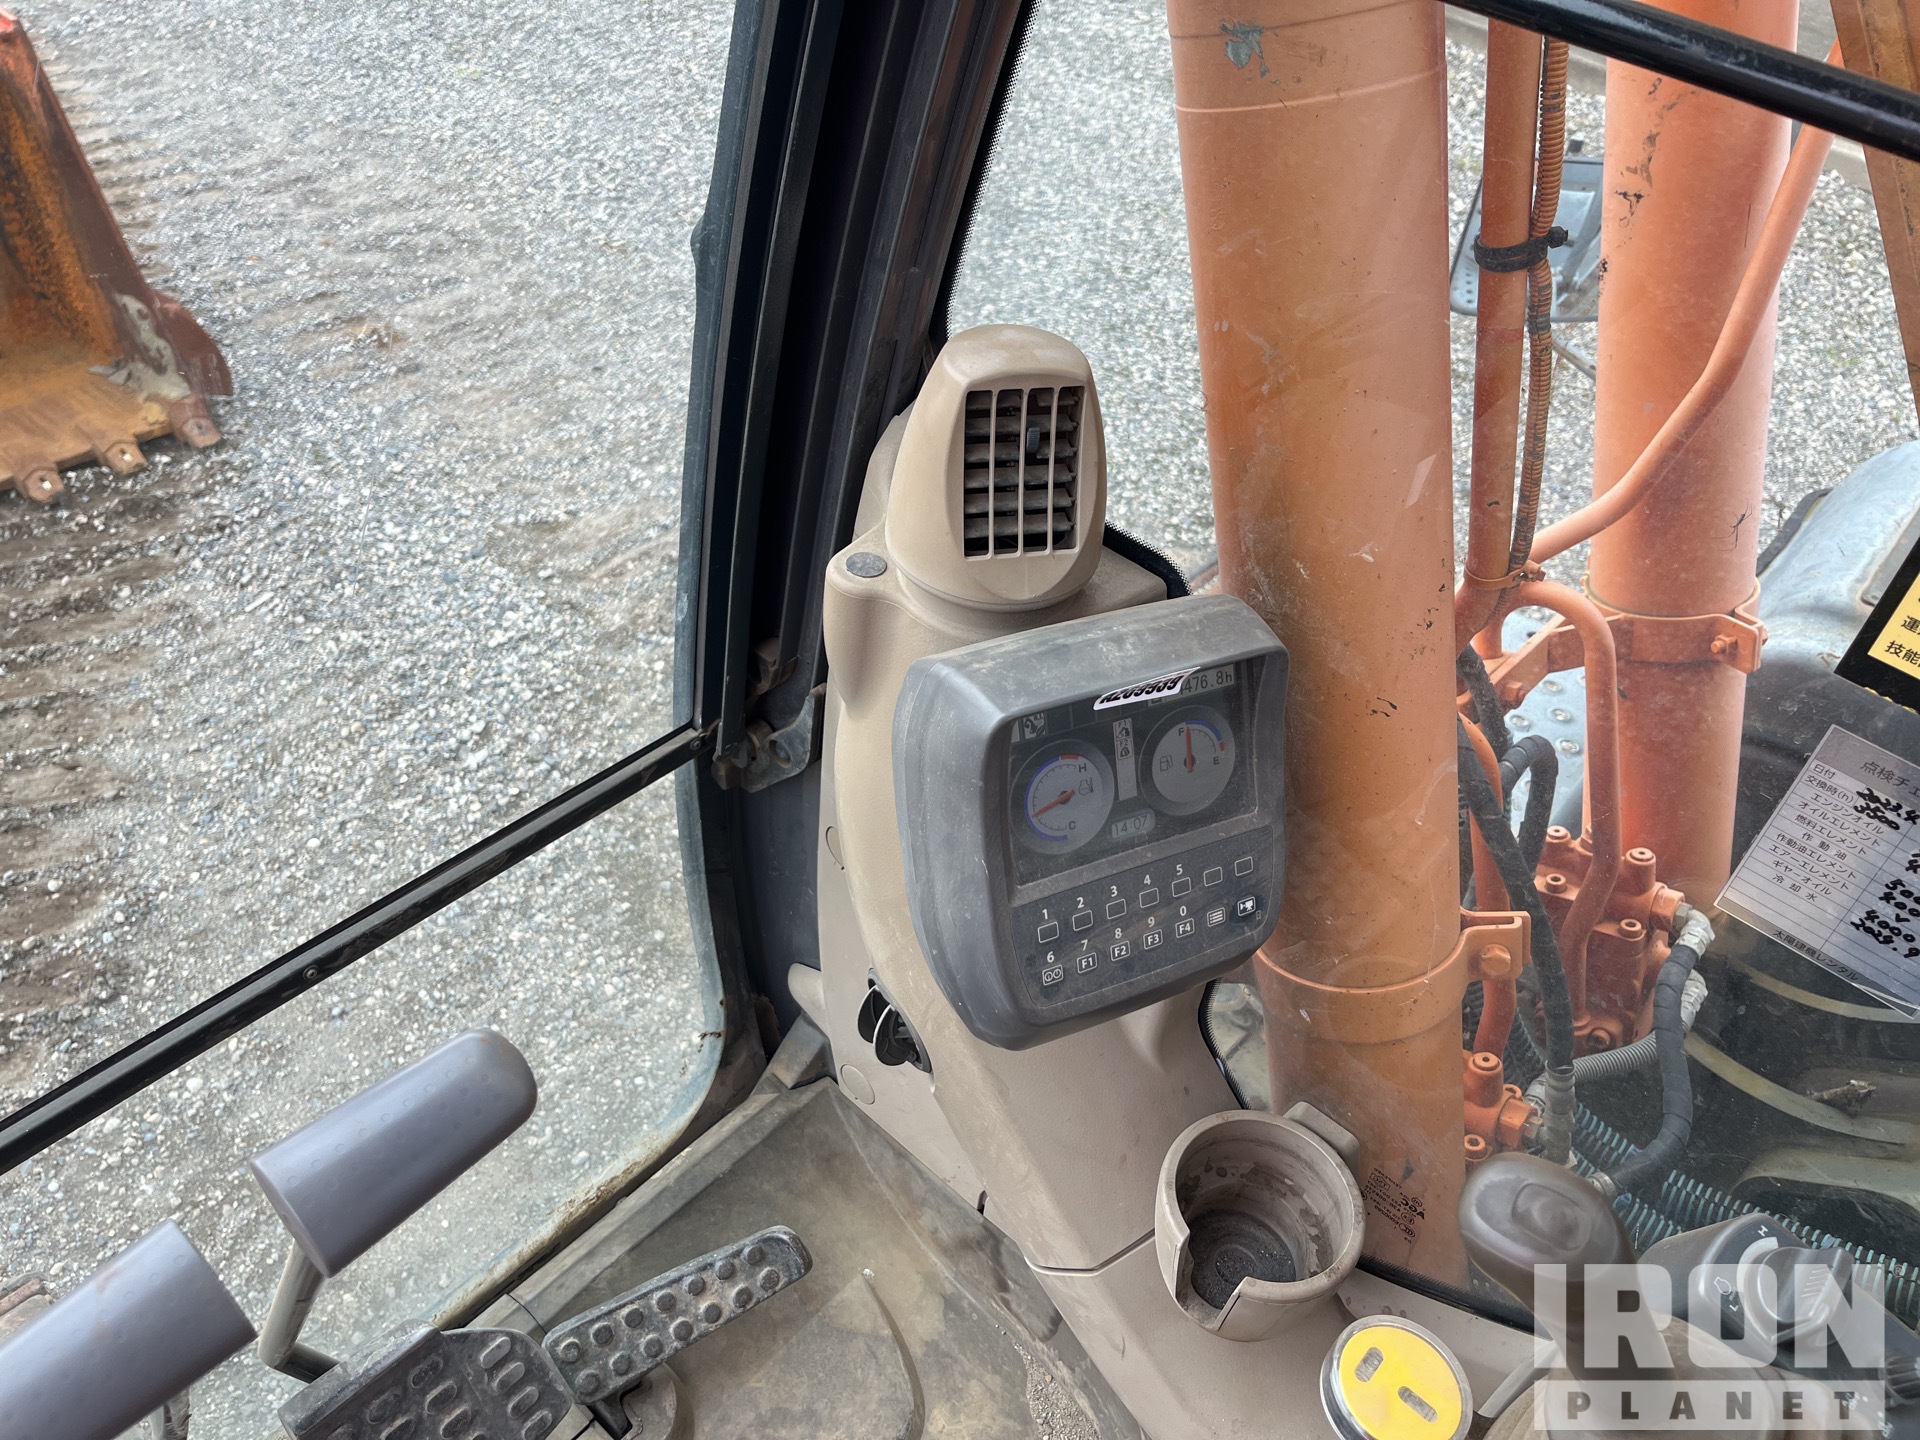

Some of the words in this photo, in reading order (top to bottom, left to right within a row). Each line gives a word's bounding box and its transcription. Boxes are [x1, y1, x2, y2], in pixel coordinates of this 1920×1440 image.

[1901, 615, 1920, 635] 運
[1884, 640, 1920, 668] 技能
[1178, 727, 1185, 737] F
[1078, 763, 1087, 773] H
[1213, 756, 1220, 765] E
[1813, 763, 1836, 780] 日付
[1068, 821, 1077, 831] C
[1798, 800, 1880, 847] オイルエレメント
[1811, 793, 1885, 835] エンジンオイル
[1794, 813, 1867, 855] 燃料エレメント
[1769, 844, 1849, 891] エアーエレメント
[1776, 832, 1857, 880] 作動油エレメント
[1042, 909, 1048, 919] 1
[1076, 897, 1085, 908] 2
[1110, 886, 1118, 897] 3
[1143, 875, 1151, 886] 4
[1176, 864, 1183, 875] 5
[1047, 951, 1055, 963] 6
[1081, 940, 1089, 950] 7
[1115, 928, 1122, 939] 8
[1148, 917, 1155, 928] 9
[1179, 905, 1187, 917] 0
[1081, 957, 1093, 969] F1
[1114, 945, 1126, 957] F2
[1147, 934, 1159, 946] F3
[1179, 922, 1191, 934] F4
[1757, 1225, 1768, 1237] H
